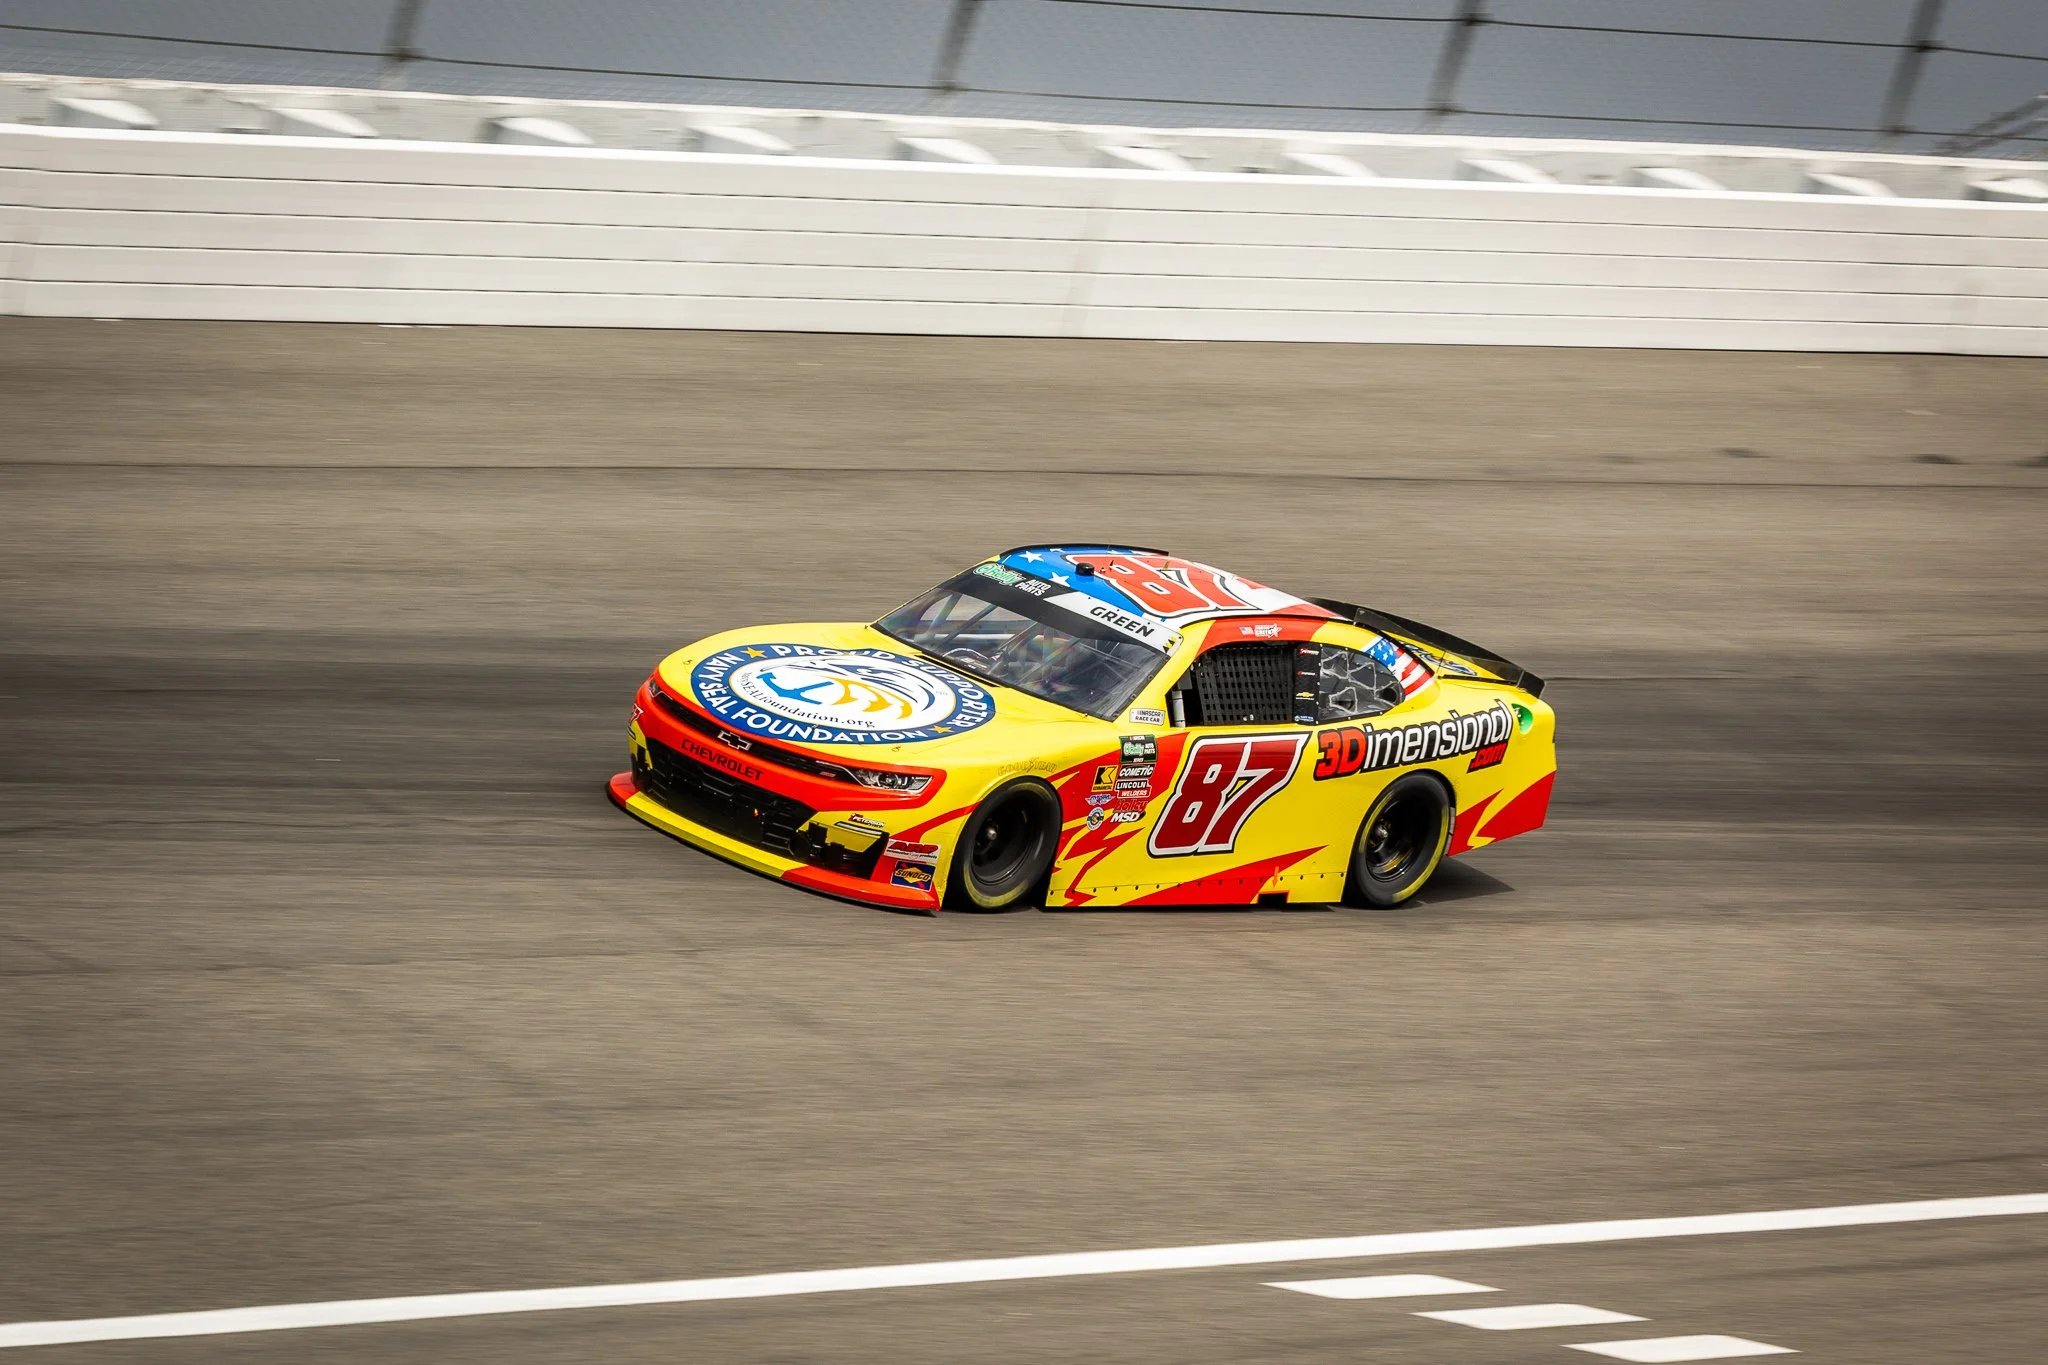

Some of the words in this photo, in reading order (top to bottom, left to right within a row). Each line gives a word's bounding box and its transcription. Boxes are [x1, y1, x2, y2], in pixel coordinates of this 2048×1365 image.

[1015, 582, 1046, 596] PARTS
[1026, 579, 1052, 592] AUTO
[1066, 555, 1256, 617] 87
[1090, 606, 1155, 637] GREEN
[698, 652, 745, 682] NAVY
[698, 682, 738, 715] SEAL
[901, 660, 988, 728] SUPPORTER
[730, 706, 929, 743] FOUNDATION
[1315, 699, 1512, 779] 3Dimensional
[681, 738, 765, 781] CHEVROLET
[1468, 742, 1508, 771] .com
[1116, 781, 1147, 790] LINCOLN
[1121, 789, 1148, 797] WELDERS
[1148, 733, 1311, 856] 87
[1110, 811, 1141, 823] MSD
[888, 841, 939, 854] ARP
[895, 868, 932, 881] SUNOCO
